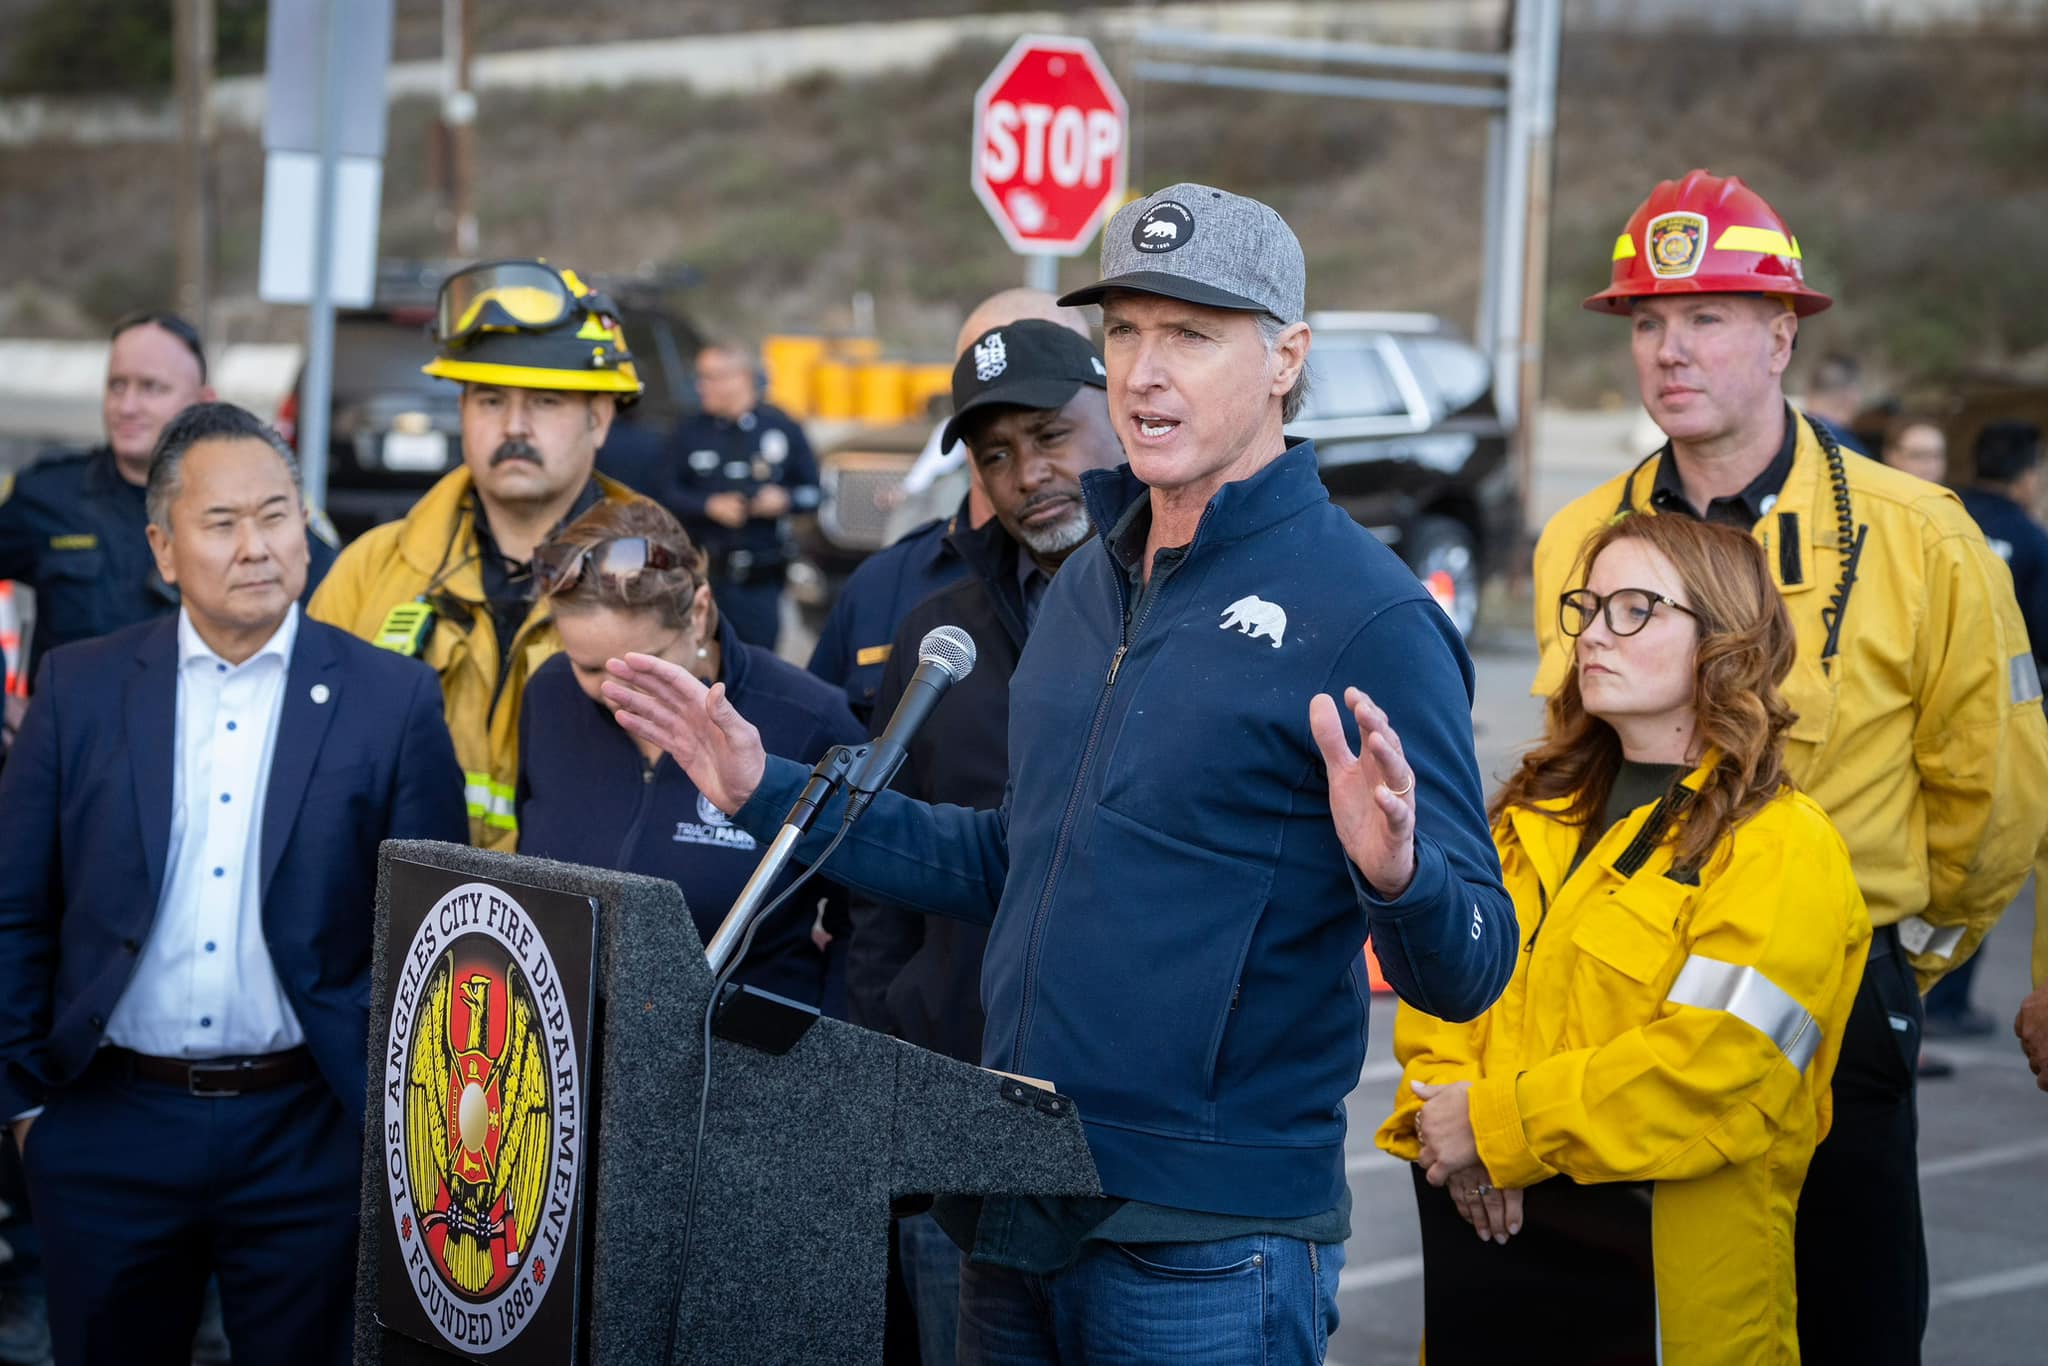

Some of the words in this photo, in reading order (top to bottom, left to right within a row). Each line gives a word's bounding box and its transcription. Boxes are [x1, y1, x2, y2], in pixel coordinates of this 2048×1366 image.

[982, 101, 1121, 188] STOP
[439, 892, 483, 937] CITY
[486, 895, 534, 962] FIRE
[388, 922, 437, 1108] ANGELES
[531, 951, 575, 1257] DEPARTMENT
[388, 1120, 407, 1207] LOS
[408, 1245, 493, 1346] FOUNDED
[498, 1277, 534, 1337] 1886
